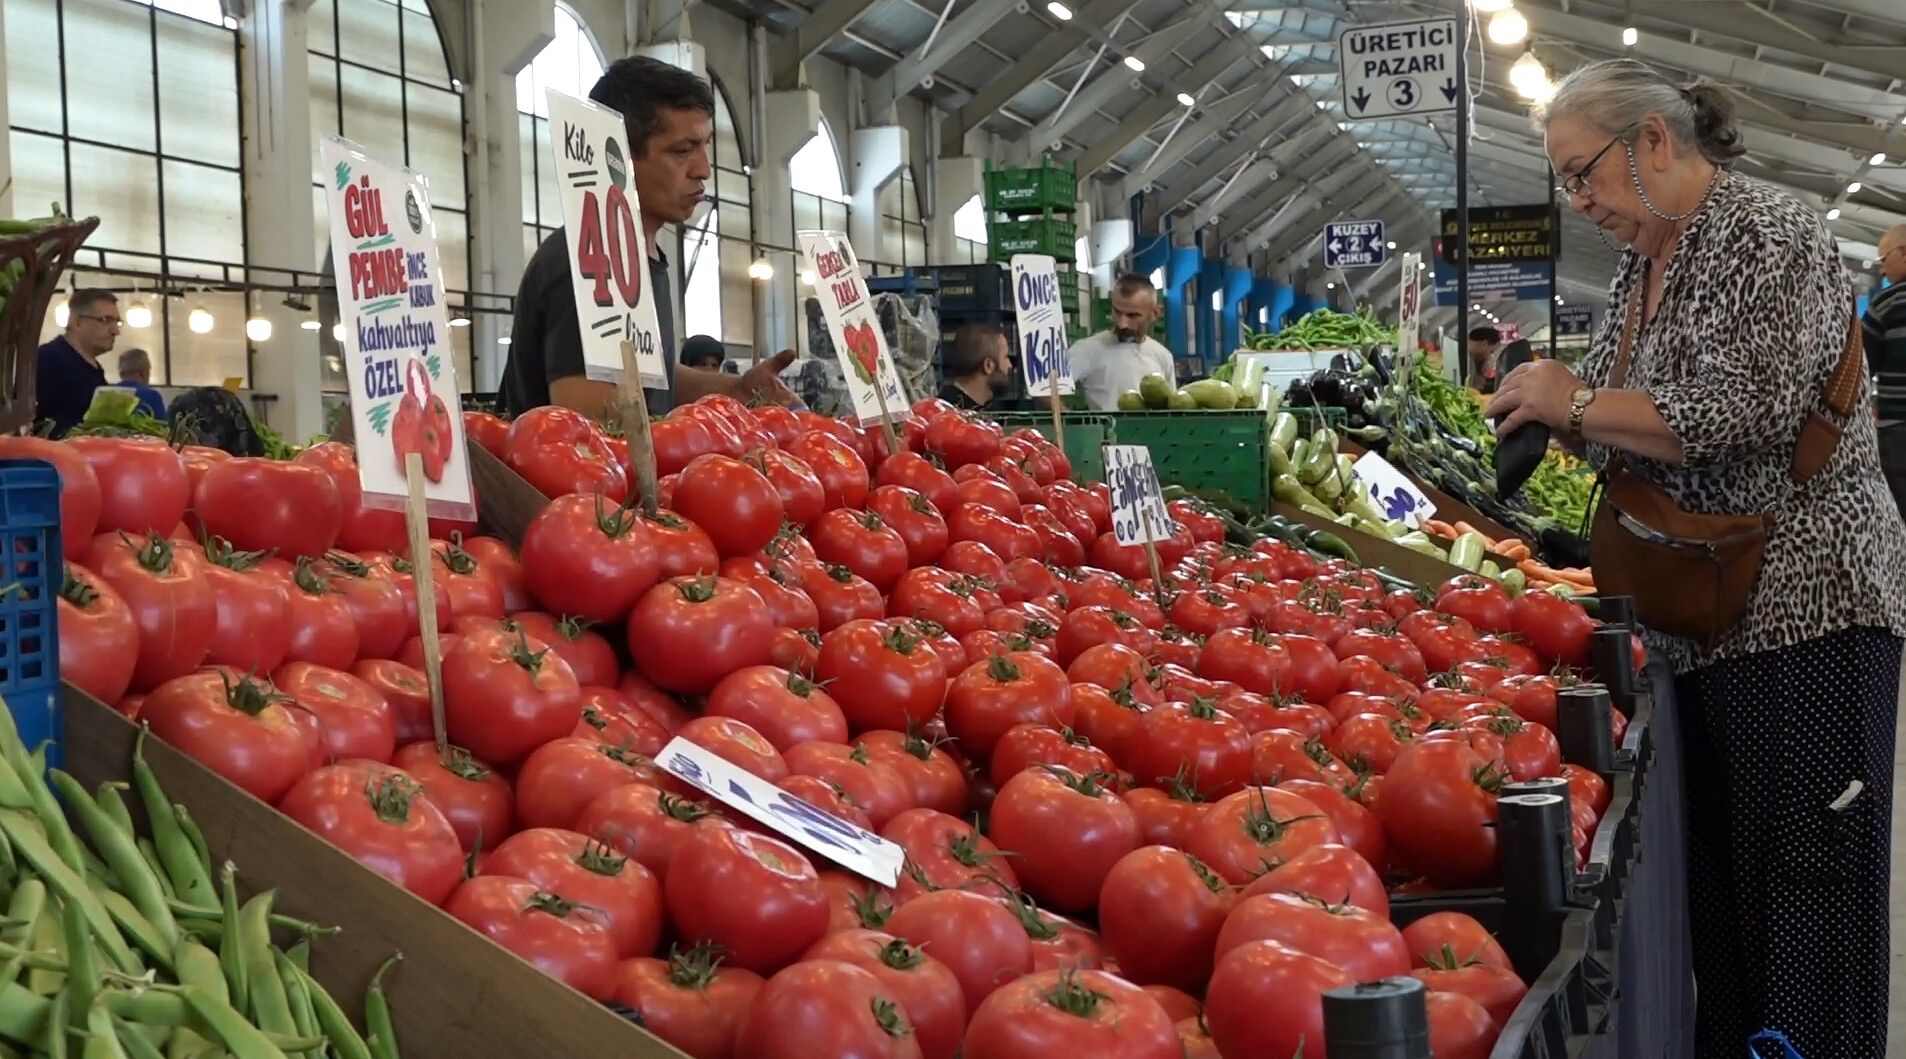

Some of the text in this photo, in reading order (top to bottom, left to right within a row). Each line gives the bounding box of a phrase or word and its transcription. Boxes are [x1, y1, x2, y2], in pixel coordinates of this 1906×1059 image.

[1350, 23, 1452, 54] ÜRETİCİ
[1364, 54, 1444, 78] PAZARI
[1394, 80, 1414, 105] 3
[564, 120, 594, 166] Kilo
[344, 175, 388, 239] GÜL
[578, 184, 641, 309] 40
[1332, 223, 1378, 236] KUZEY
[1350, 237, 1360, 251] 2
[348, 248, 407, 300] PEMBE
[356, 315, 436, 356] kahvaltıya
[364, 356, 404, 400] ÖZEL
